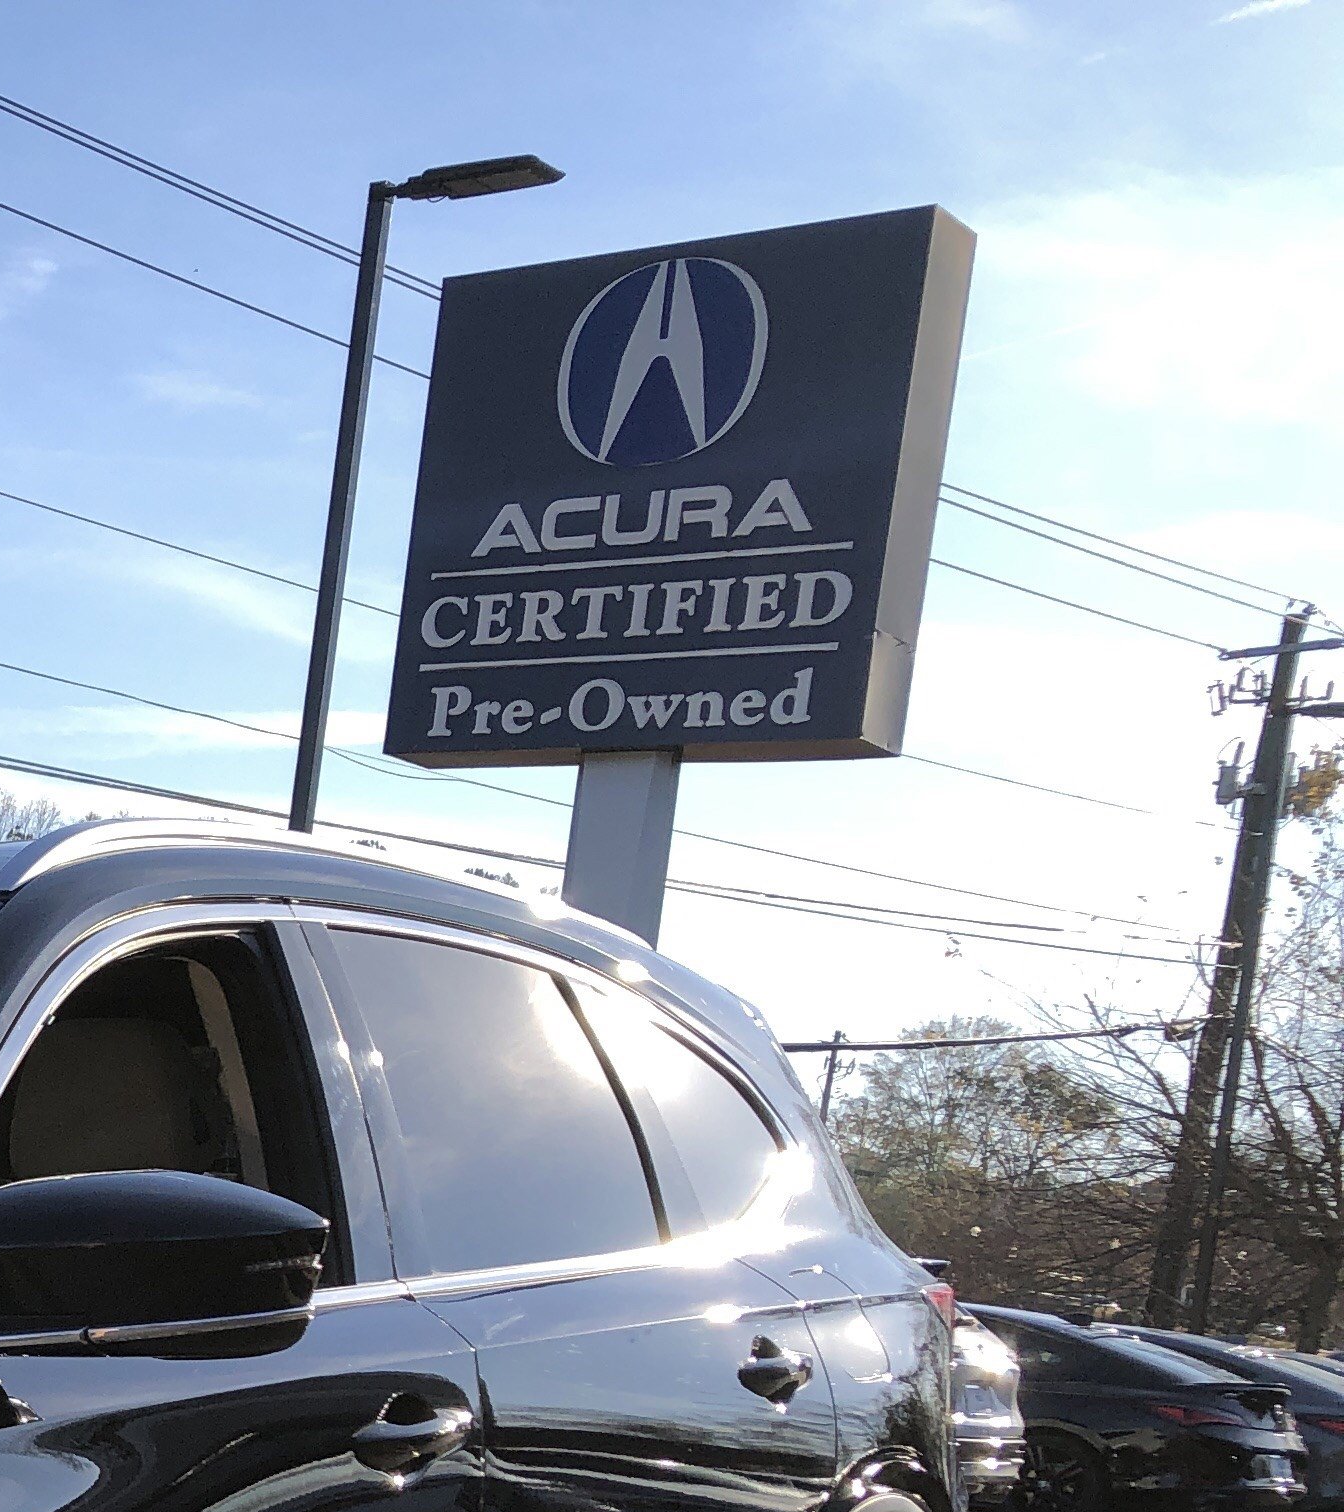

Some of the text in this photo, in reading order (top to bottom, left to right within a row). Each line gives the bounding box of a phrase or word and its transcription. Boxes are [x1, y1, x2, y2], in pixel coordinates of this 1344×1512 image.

[471, 478, 813, 558] ACURA
[420, 569, 854, 649] CERTIFIED
[426, 667, 814, 738] Pre-Owned
